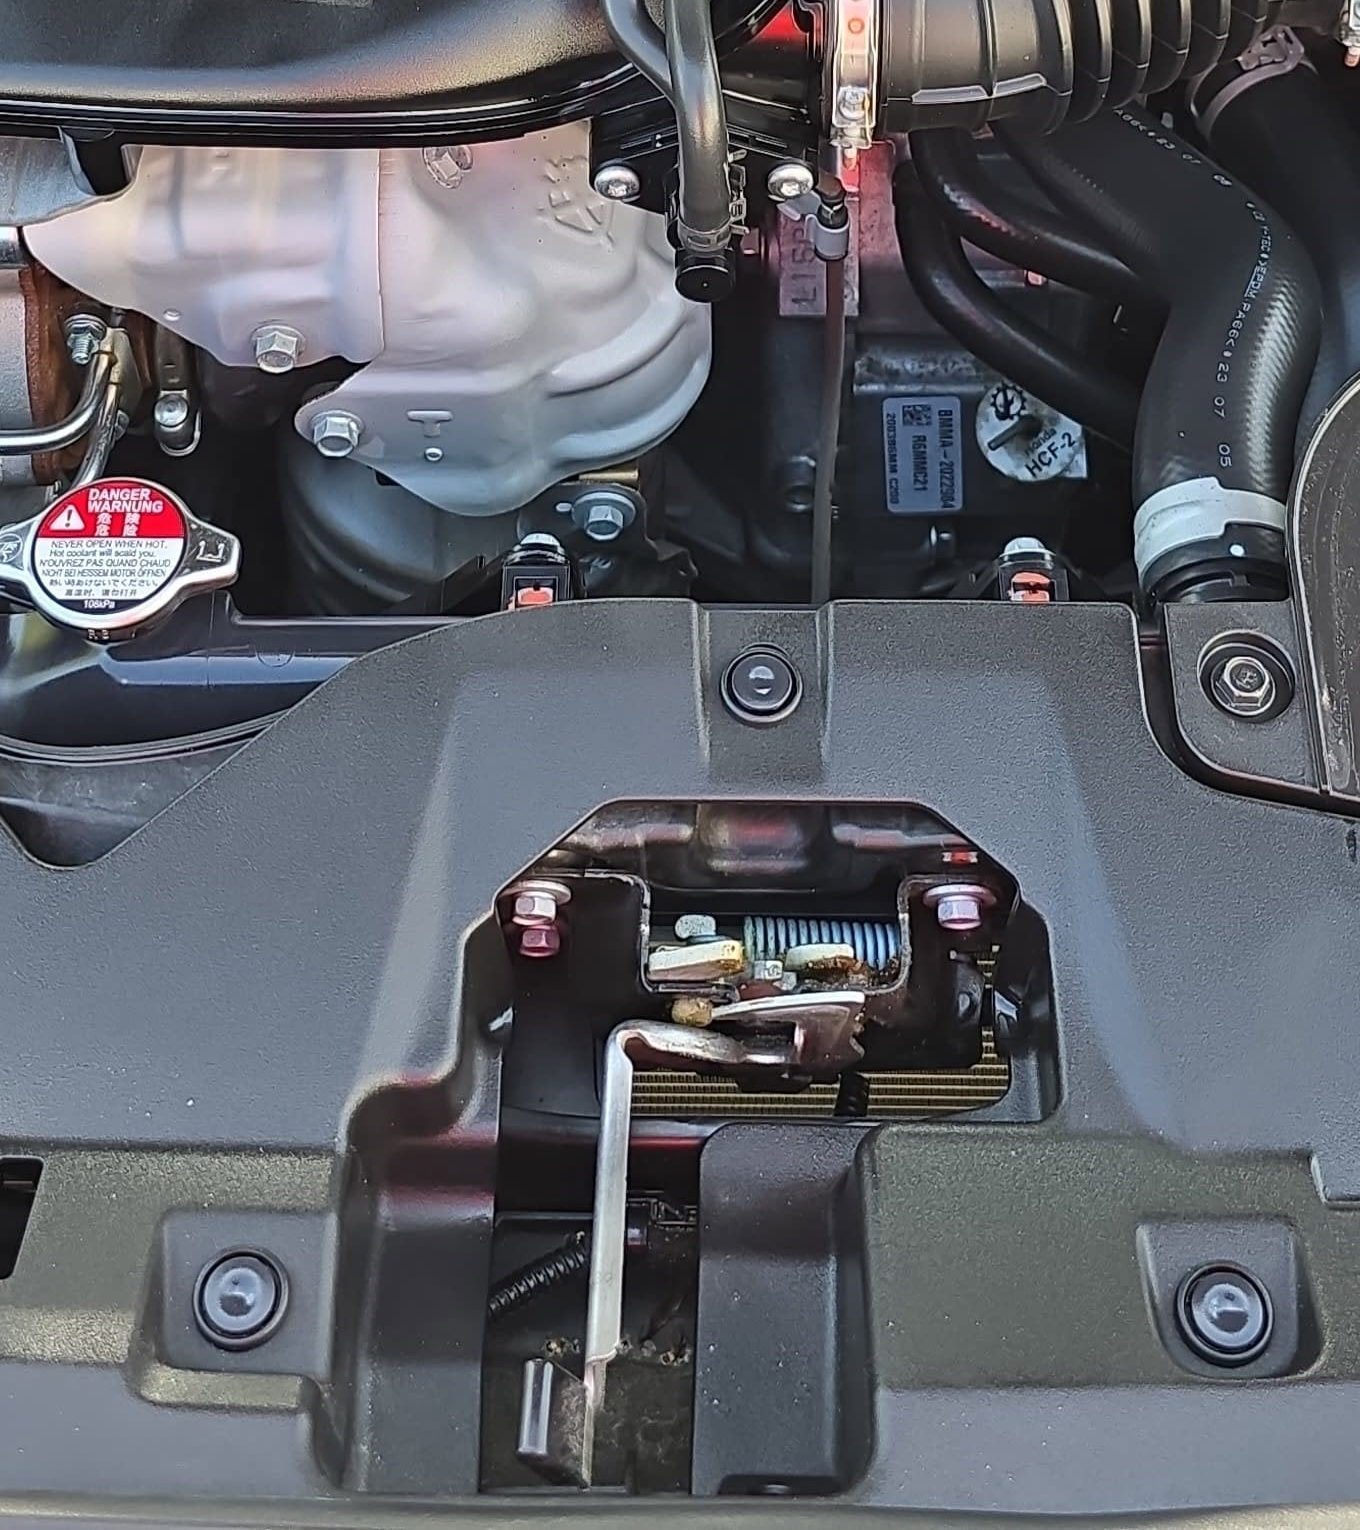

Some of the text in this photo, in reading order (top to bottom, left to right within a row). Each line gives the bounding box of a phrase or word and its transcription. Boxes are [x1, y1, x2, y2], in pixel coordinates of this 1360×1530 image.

[1217, 362, 1229, 383] 23
[1214, 396, 1225, 419] 07
[1025, 431, 1076, 478] HCF-2
[1218, 444, 1232, 468] 05
[88, 488, 152, 501] DANGER
[87, 500, 164, 513] WARNUNG
[51, 540, 84, 548] NEVER
[86, 540, 112, 548] OPEN
[115, 540, 143, 548] WHEN
[49, 549, 65, 557] Hot
[66, 549, 97, 557] coolant
[99, 549, 113, 557] will
[114, 549, 136, 557] scald
[86, 559, 104, 567] PAS
[105, 559, 138, 567] QUAND
[41, 569, 63, 577] NICHT
[110, 569, 136, 577] MOTOR
